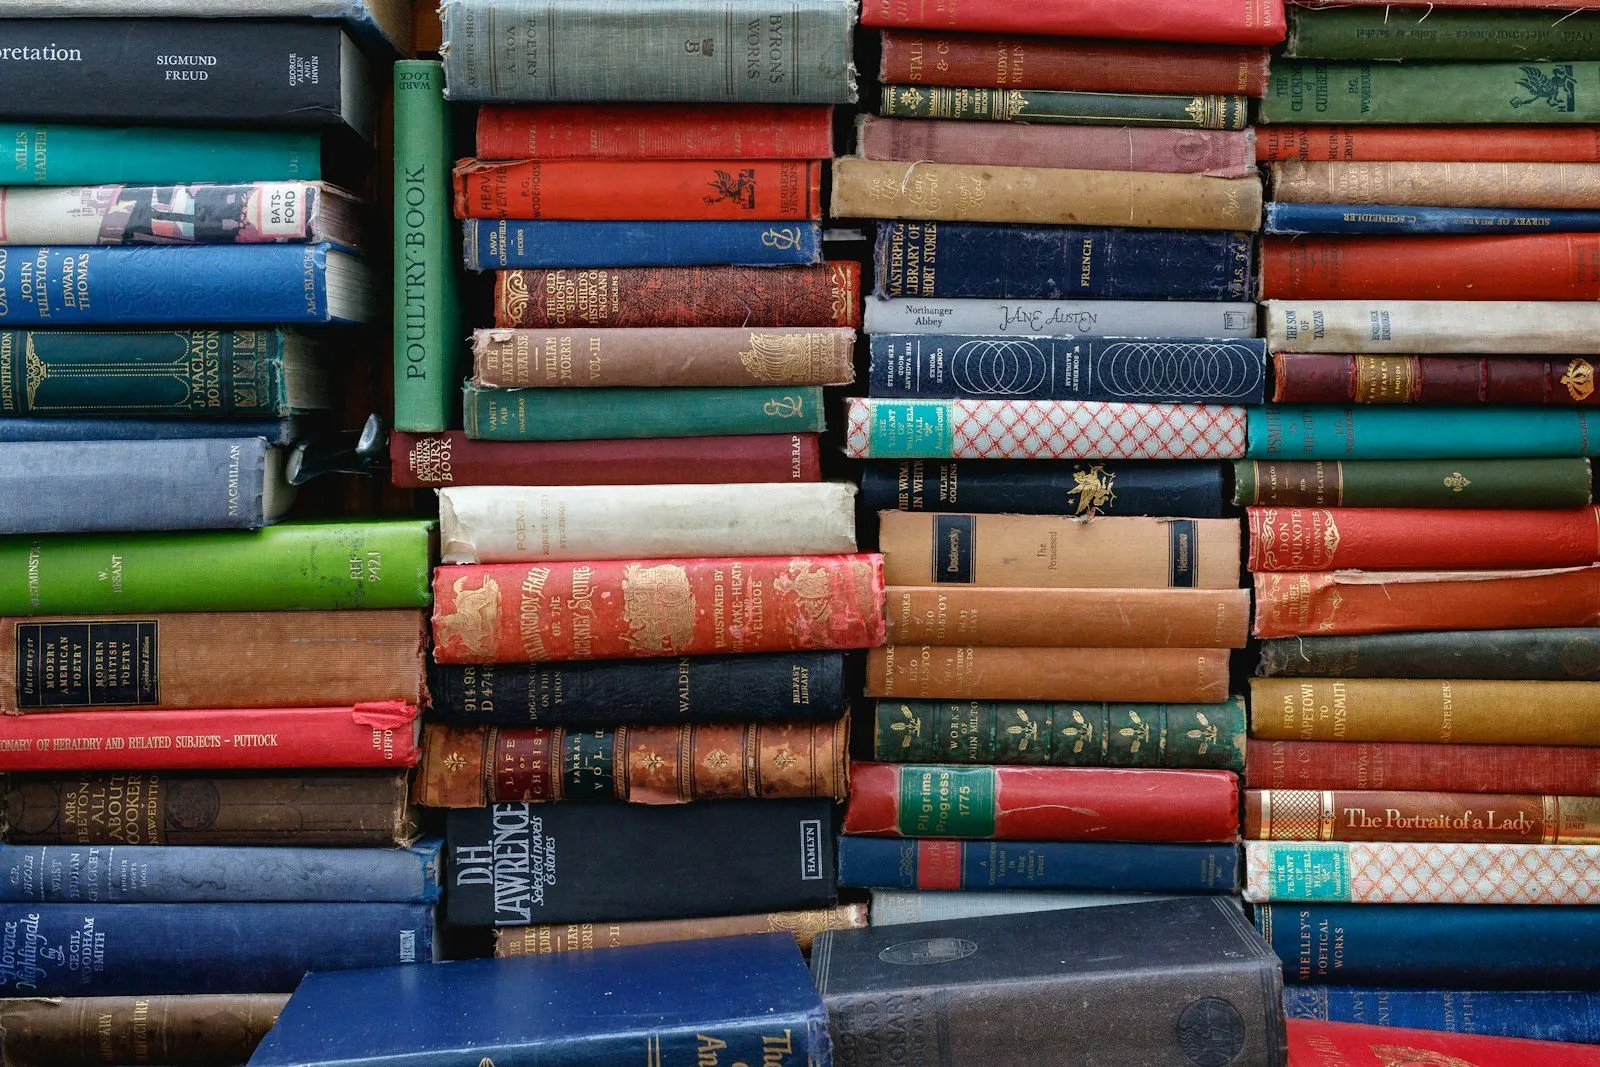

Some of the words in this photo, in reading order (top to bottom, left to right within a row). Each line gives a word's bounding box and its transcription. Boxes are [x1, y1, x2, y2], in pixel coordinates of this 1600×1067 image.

[0, 43, 82, 62] retation
[156, 55, 217, 67] SIGMUND
[526, 19, 536, 78] POETRY
[748, 19, 760, 78] WORKS
[769, 15, 783, 84] BYRON'S
[165, 70, 209, 82] FREUD
[289, 52, 297, 87] GEORGE
[296, 56, 304, 83] ALLEN
[304, 60, 312, 80] AND
[311, 56, 319, 84] UNWIN
[400, 72, 430, 81] LOCK
[1276, 76, 1288, 97] THE
[15, 131, 28, 172] MILES
[270, 189, 282, 225] BATS-
[284, 190, 297, 225] FORD
[1343, 213, 1405, 225] SCHMEIDLER
[1497, 216, 1510, 226] OF
[1514, 216, 1550, 226] SURVEY
[490, 231, 499, 256] DAVID
[499, 220, 507, 267] COPPERFIELD
[905, 224, 920, 239] OF
[921, 222, 937, 263] STORIES
[21, 261, 33, 303] JOHN
[62, 256, 76, 308] EDWARD
[76, 252, 90, 311] THOMAS
[905, 242, 920, 295] LIBRARY
[921, 266, 937, 298] SHORT
[1080, 239, 1092, 288] FRENCH
[547, 273, 556, 294] OLD
[566, 279, 576, 311] SHOP
[578, 272, 589, 311] CHILD'S
[598, 270, 608, 319] ENGLAND
[611, 276, 619, 313] DICKENS
[547, 297, 556, 317] THE
[589, 282, 599, 324] HISTORY
[905, 305, 953, 317] Northanger
[914, 316, 943, 328] Abbey
[1285, 310, 1297, 325] SON
[1285, 326, 1297, 341] THE
[1301, 320, 1309, 331] OF
[1313, 310, 1325, 341] TARZAN
[191, 330, 206, 394] MACLAIR
[488, 349, 499, 371] THE
[517, 335, 530, 383] PARADISE
[545, 337, 558, 381] WILLIAM
[560, 336, 573, 381] MORRIS
[887, 344, 895, 358] TEN
[936, 347, 944, 383] COMPLETE
[1073, 345, 1081, 353] W.
[2, 332, 14, 411] IDENTIFICATION
[207, 330, 220, 408] BORASTON
[887, 360, 895, 387] NOVELS
[904, 357, 912, 390] VAGRANT
[1072, 355, 1080, 392] SOMERSET
[500, 406, 508, 425] FAIR
[879, 418, 887, 437] THE
[888, 409, 896, 448] TENANT
[897, 423, 905, 436] OF
[906, 405, 914, 451] WILDFELL
[915, 416, 923, 442] HALL
[409, 451, 417, 471] THE
[416, 440, 424, 481] ARTHUR
[423, 438, 431, 482] RACKHAM
[430, 438, 442, 483] FAIRY
[441, 438, 453, 483] BOOK
[792, 435, 801, 479] HARRAP
[229, 445, 241, 517] MACMILLAN
[940, 465, 948, 501] WILKIE
[949, 463, 957, 504] COLLINS
[913, 497, 924, 508] IN
[947, 527, 961, 573] Dostoevsky
[1037, 542, 1047, 558] The
[1049, 530, 1058, 571] Possessed
[1178, 533, 1189, 572] Heinemann
[1279, 522, 1290, 553] DON
[1291, 510, 1303, 566] QUIXOTE
[1312, 511, 1322, 565] CERVANTES
[568, 565, 597, 610] SQUIRE
[714, 569, 725, 582] BY
[714, 584, 725, 648] ILLUSTRATED
[1289, 583, 1299, 617] THREE
[24, 637, 35, 695] Untermeyer
[46, 642, 55, 689] MODERN
[60, 636, 69, 694] AMERICAN
[73, 643, 82, 687] POETRY
[95, 641, 104, 687] MODERN
[109, 641, 118, 687] BRITISH
[122, 641, 131, 686] POETRY
[142, 635, 151, 660] Edition
[678, 658, 689, 712] WALDEN
[791, 665, 801, 704] BELFAST
[800, 667, 810, 705] LIBRARY
[910, 659, 918, 682] LEO
[950, 704, 960, 749] WORKS
[1283, 694, 1294, 730] FROM
[1320, 705, 1328, 720] TO
[0, 739, 31, 753] ONARY
[38, 738, 50, 751] OF
[53, 737, 102, 751] HERALDRY
[105, 737, 125, 750] AND
[128, 736, 172, 749] RELATED
[175, 735, 222, 749] SUBJECTS
[234, 734, 278, 748] PUTTOCK
[504, 739, 515, 786] LIFE
[532, 727, 543, 795] CHRIST
[970, 736, 979, 760] JOHN
[65, 791, 77, 824] MRS
[91, 787, 105, 825] ALL
[108, 774, 124, 841] ABOUT
[917, 772, 933, 831] Pilgrims
[937, 772, 951, 832] Progress
[958, 785, 970, 817] 1775
[530, 815, 545, 854] novels
[1344, 807, 1382, 829] The
[1385, 808, 1452, 831] Portrait
[1452, 809, 1474, 830] of
[1472, 818, 1483, 830] a
[1487, 810, 1535, 835] Lady
[1564, 822, 1585, 830] JAMES
[456, 840, 494, 886] D.H.
[493, 801, 531, 926] LAWRENCE
[544, 836, 556, 874] stories
[806, 827, 817, 873] HAMLYN
[927, 842, 940, 880] Mark
[998, 850, 1006, 878] Yankee
[1017, 855, 1026, 874] King
[1037, 855, 1045, 876] Court
[51, 859, 62, 892] WEST
[70, 852, 81, 898] INDIAN
[88, 848, 100, 902] CRICKET
[530, 854, 545, 906] Selected
[1277, 865, 1286, 883] THE
[1287, 854, 1295, 894] TENANT
[1304, 851, 1312, 898] WILDFELL
[1314, 863, 1322, 889] HALL
[1332, 877, 1341, 897] Anne
[16, 913, 47, 989] Nightingale
[40, 945, 65, 967] by
[69, 930, 81, 971] CECIL
[81, 917, 95, 984] WOODHAM
[94, 932, 105, 972] SMITH
[1300, 910, 1310, 981] SHELLEY'S
[1318, 918, 1328, 975] POETICAL
[1334, 926, 1344, 969] WORKS
